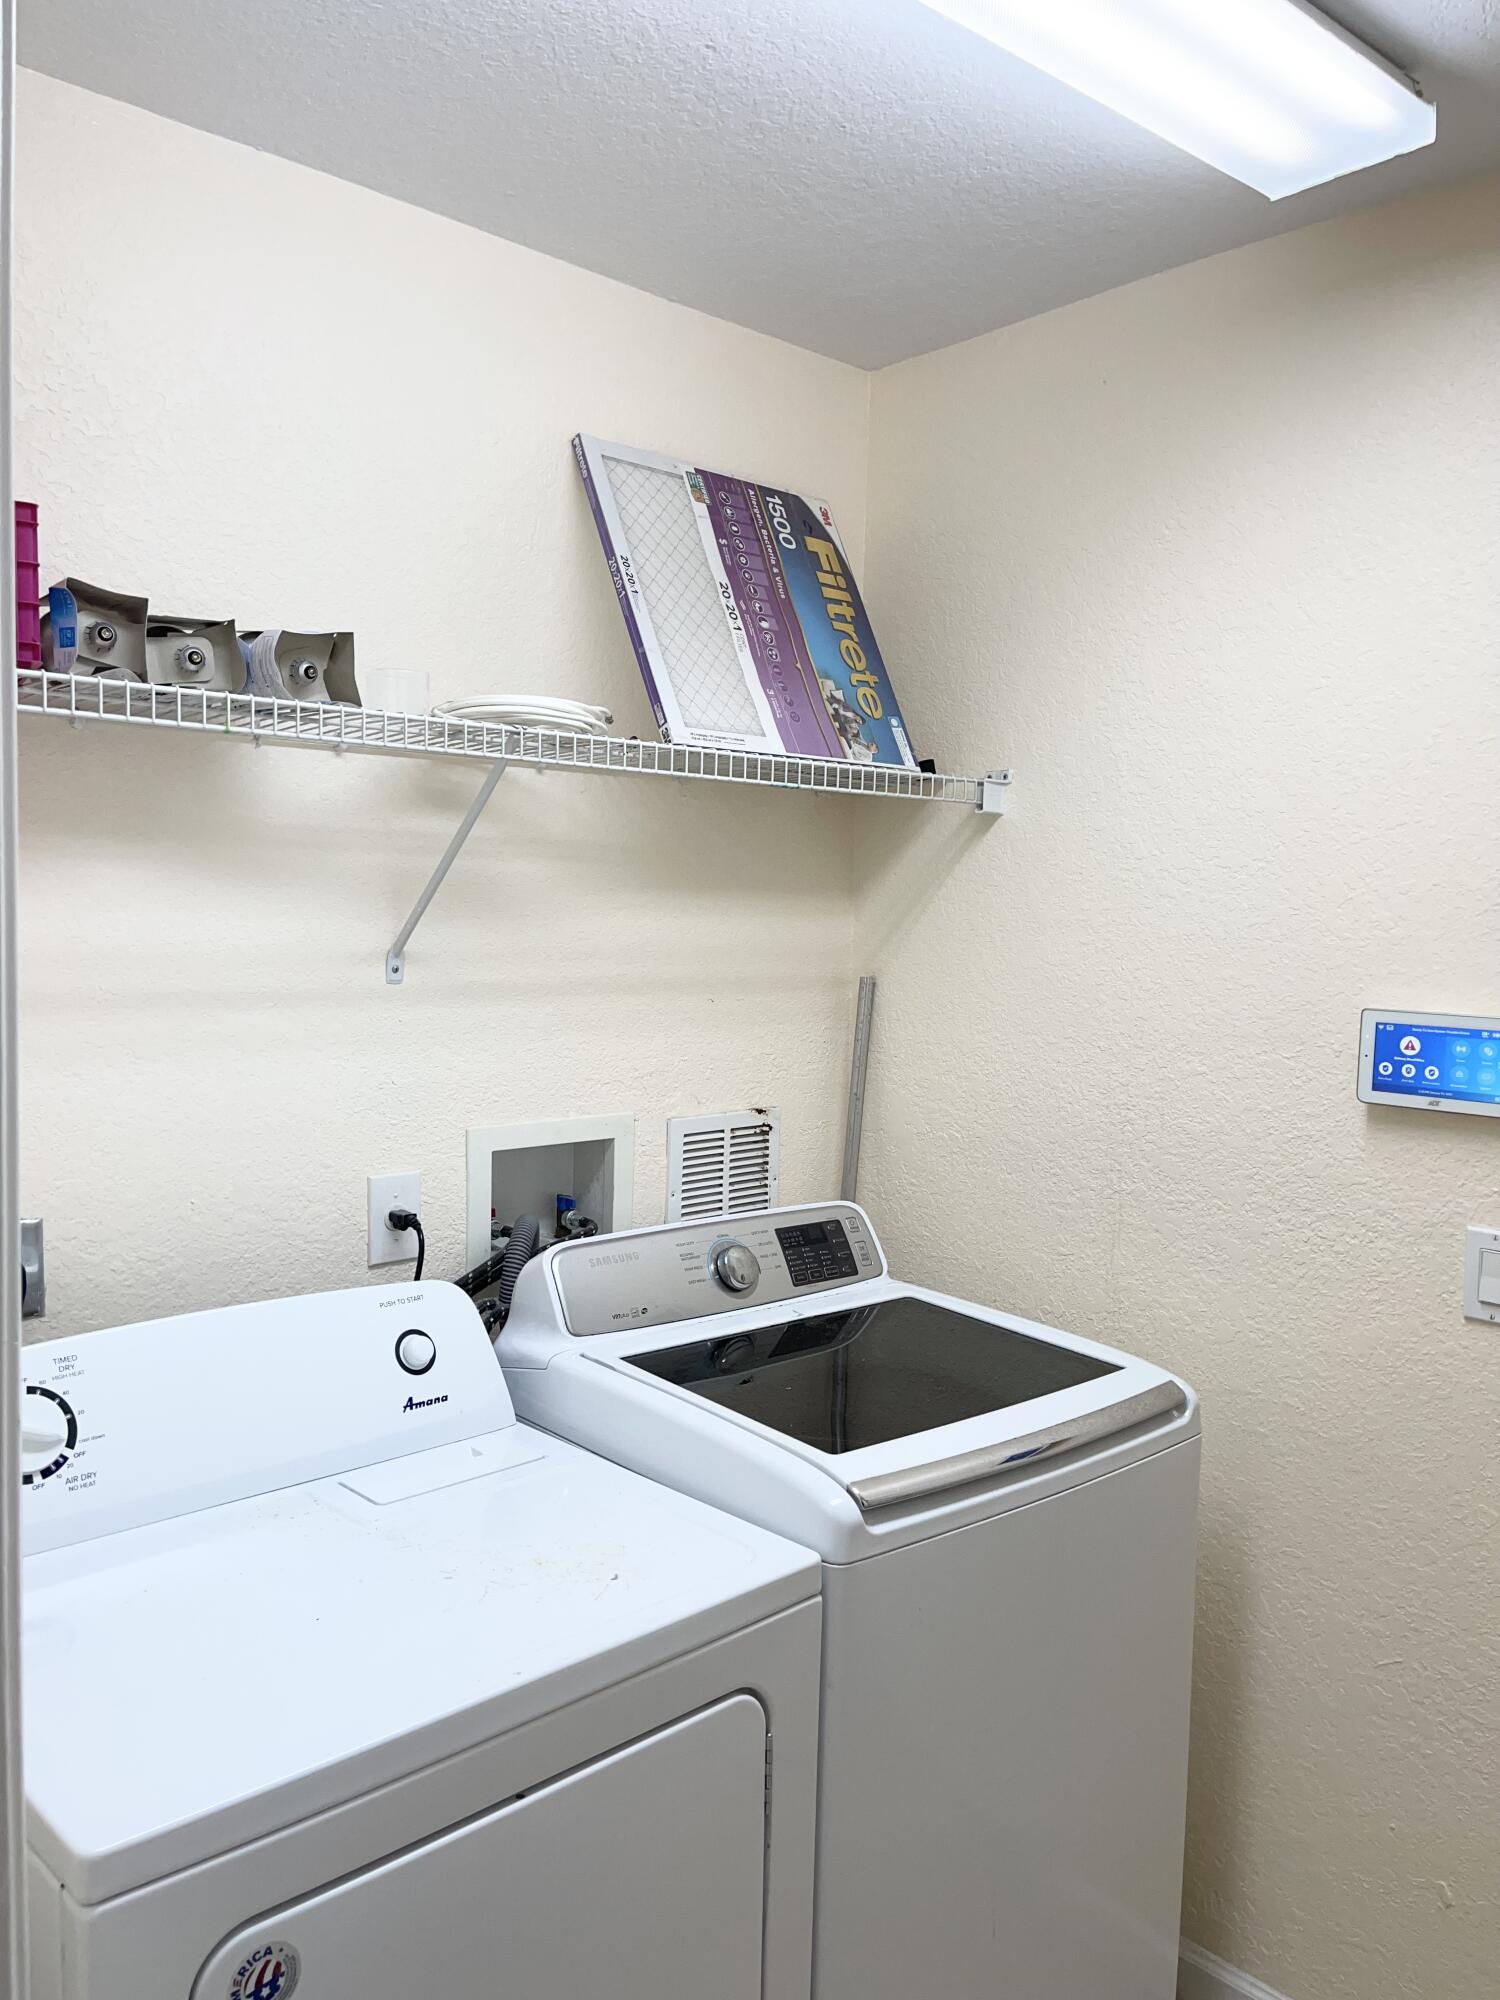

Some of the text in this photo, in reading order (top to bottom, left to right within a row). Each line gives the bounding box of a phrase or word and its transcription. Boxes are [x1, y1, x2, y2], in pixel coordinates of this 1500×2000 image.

[765, 495, 797, 549] 1500
[819, 506, 832, 527] 3M
[748, 488, 764, 526] Allergen,
[761, 529, 776, 565] Bacteria
[775, 576, 786, 599] Virus
[803, 535, 883, 720] Filtrete
[588, 1251, 640, 1268] SAMSUNG
[379, 1301, 397, 1309] PUSH
[406, 1294, 424, 1304] START
[52, 1354, 78, 1365] TIMED
[58, 1364, 75, 1373] DRY
[68, 1369, 85, 1377] HEAT
[402, 1395, 449, 1414] Amana
[73, 1450, 87, 1459] OFF
[65, 1471, 97, 1485] AIR DRY
[31, 1482, 46, 1491] OFF
[68, 1480, 97, 1492] NO HEAT
[230, 1945, 273, 2000] MERICA
